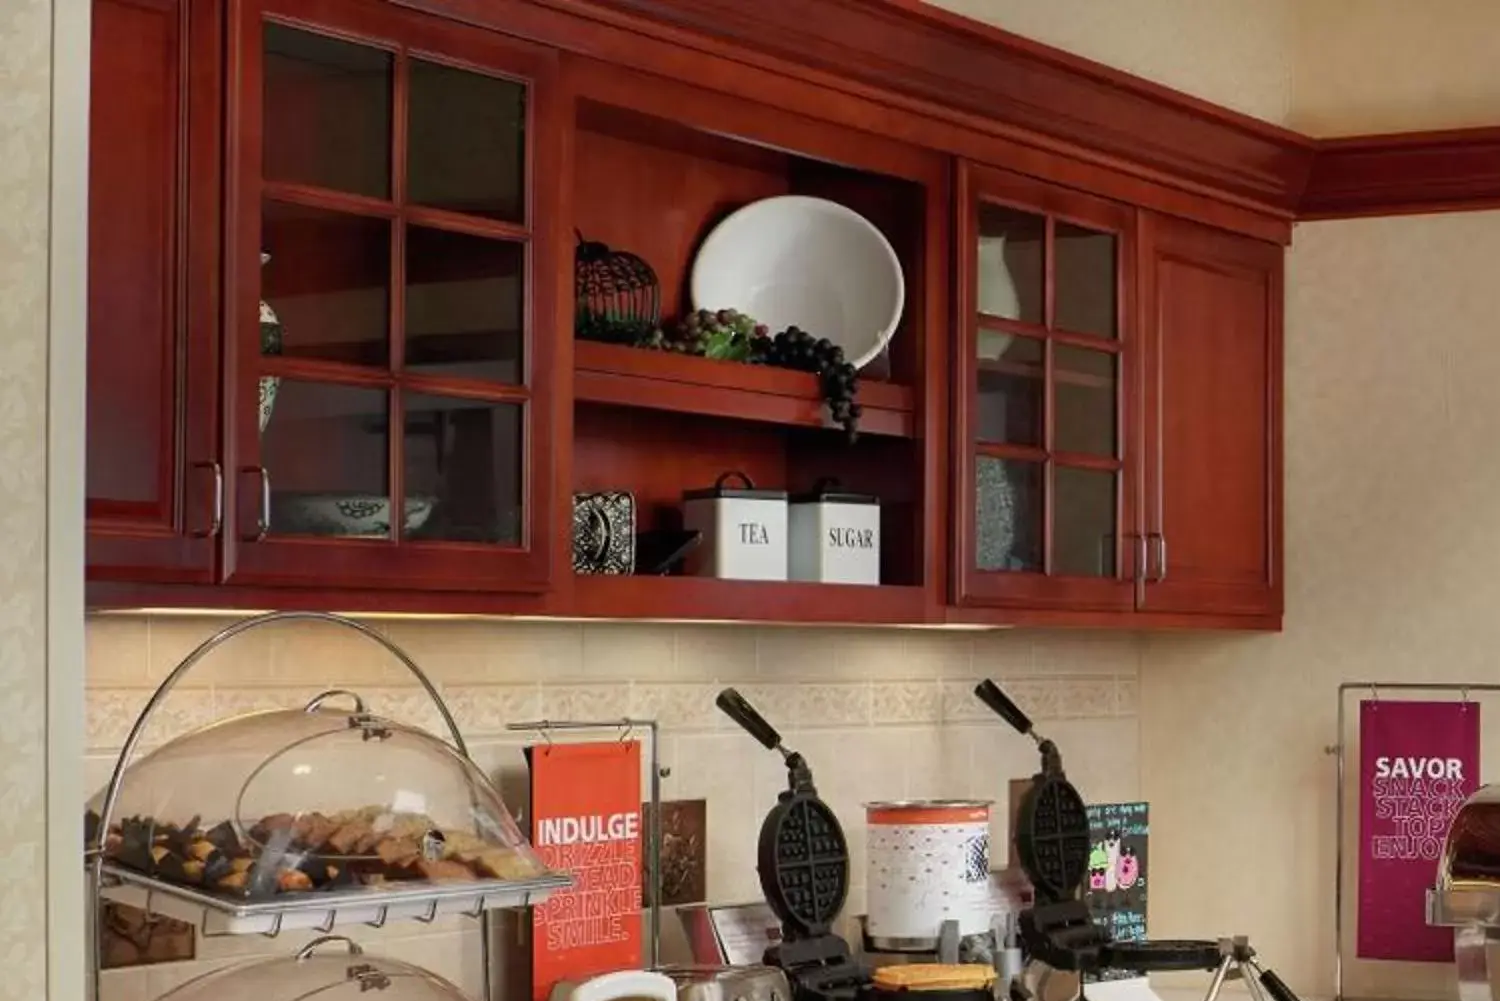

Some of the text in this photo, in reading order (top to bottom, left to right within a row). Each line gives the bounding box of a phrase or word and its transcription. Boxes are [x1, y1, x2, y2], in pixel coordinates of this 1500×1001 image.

[739, 522, 770, 545] TEA
[828, 527, 873, 549] SUGAR
[1375, 756, 1464, 779] SAVOR
[1373, 777, 1467, 799] SNACK
[1375, 797, 1461, 819] STACK
[538, 812, 639, 846] INDULGE
[1372, 834, 1447, 860] ENJO
[534, 888, 643, 927] SPRINKLE
[546, 915, 632, 951] SMILE.
